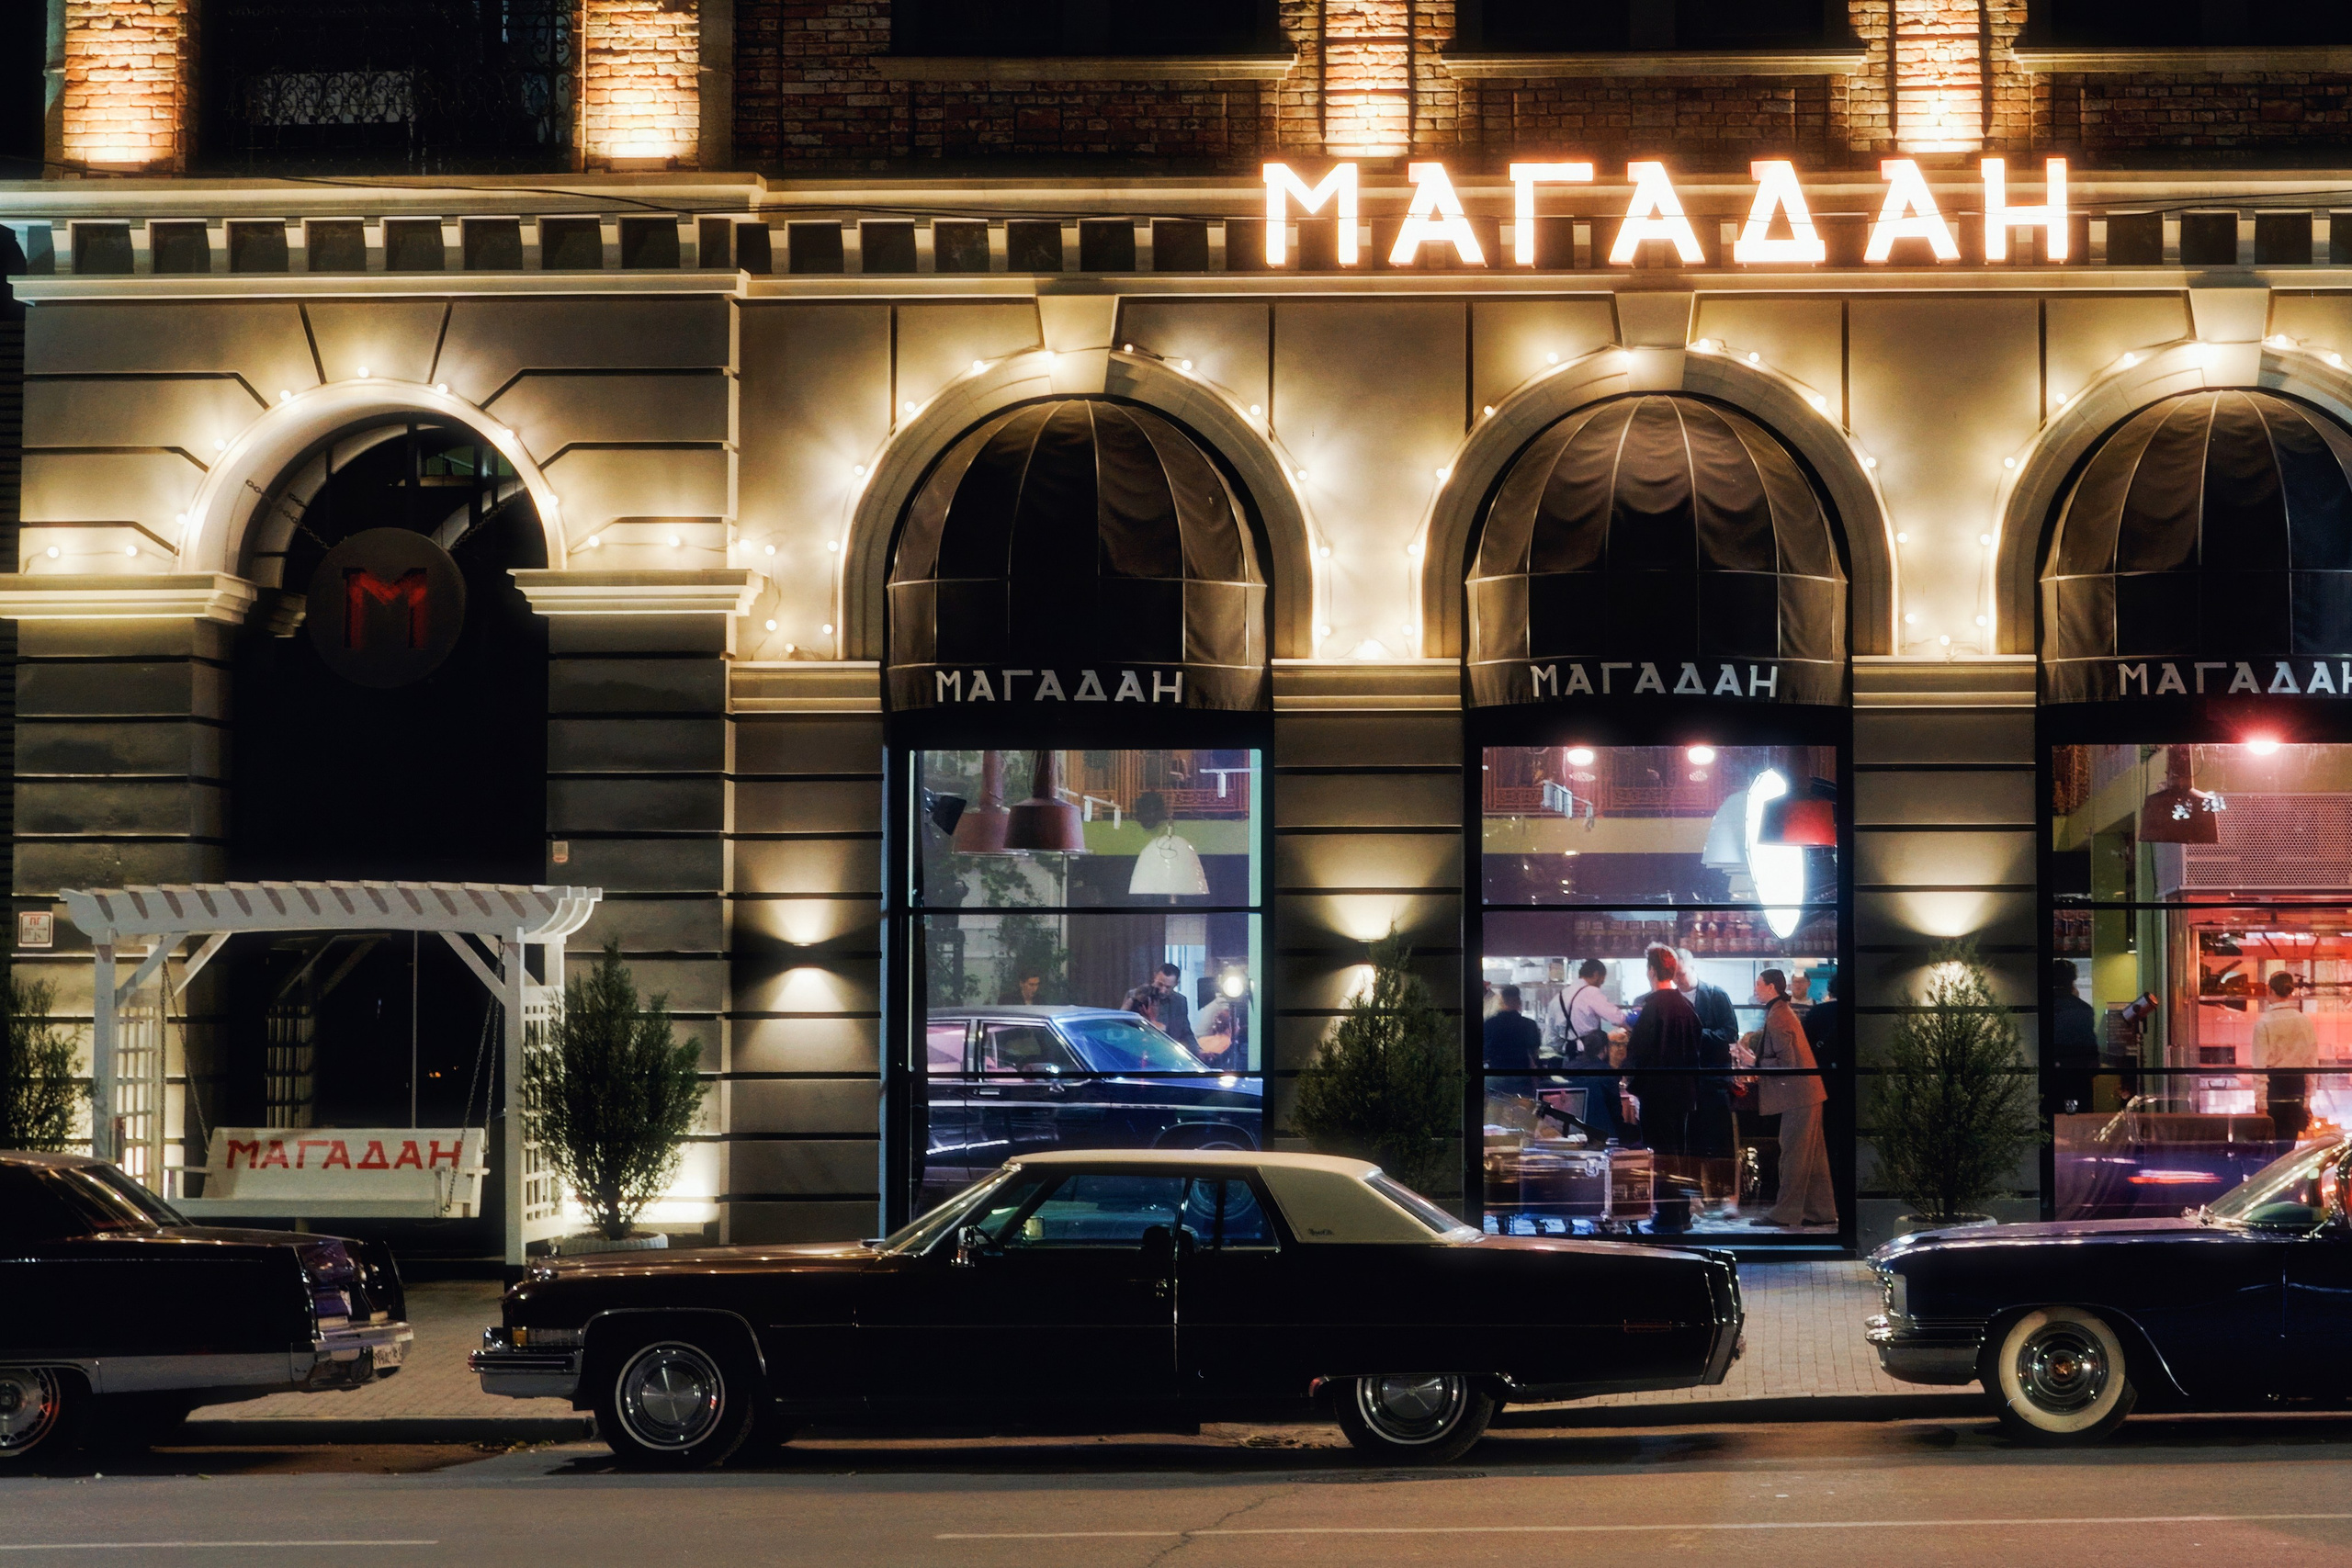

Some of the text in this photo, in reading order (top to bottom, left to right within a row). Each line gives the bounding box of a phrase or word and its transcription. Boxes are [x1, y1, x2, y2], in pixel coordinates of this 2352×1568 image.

[1262, 157, 2069, 265] МАГАДАН
[342, 567, 428, 650] М
[935, 670, 1183, 703] МАГАДАН
[1530, 662, 1778, 697] МАГАДАН
[226, 1140, 461, 1169] МАГАДАН
